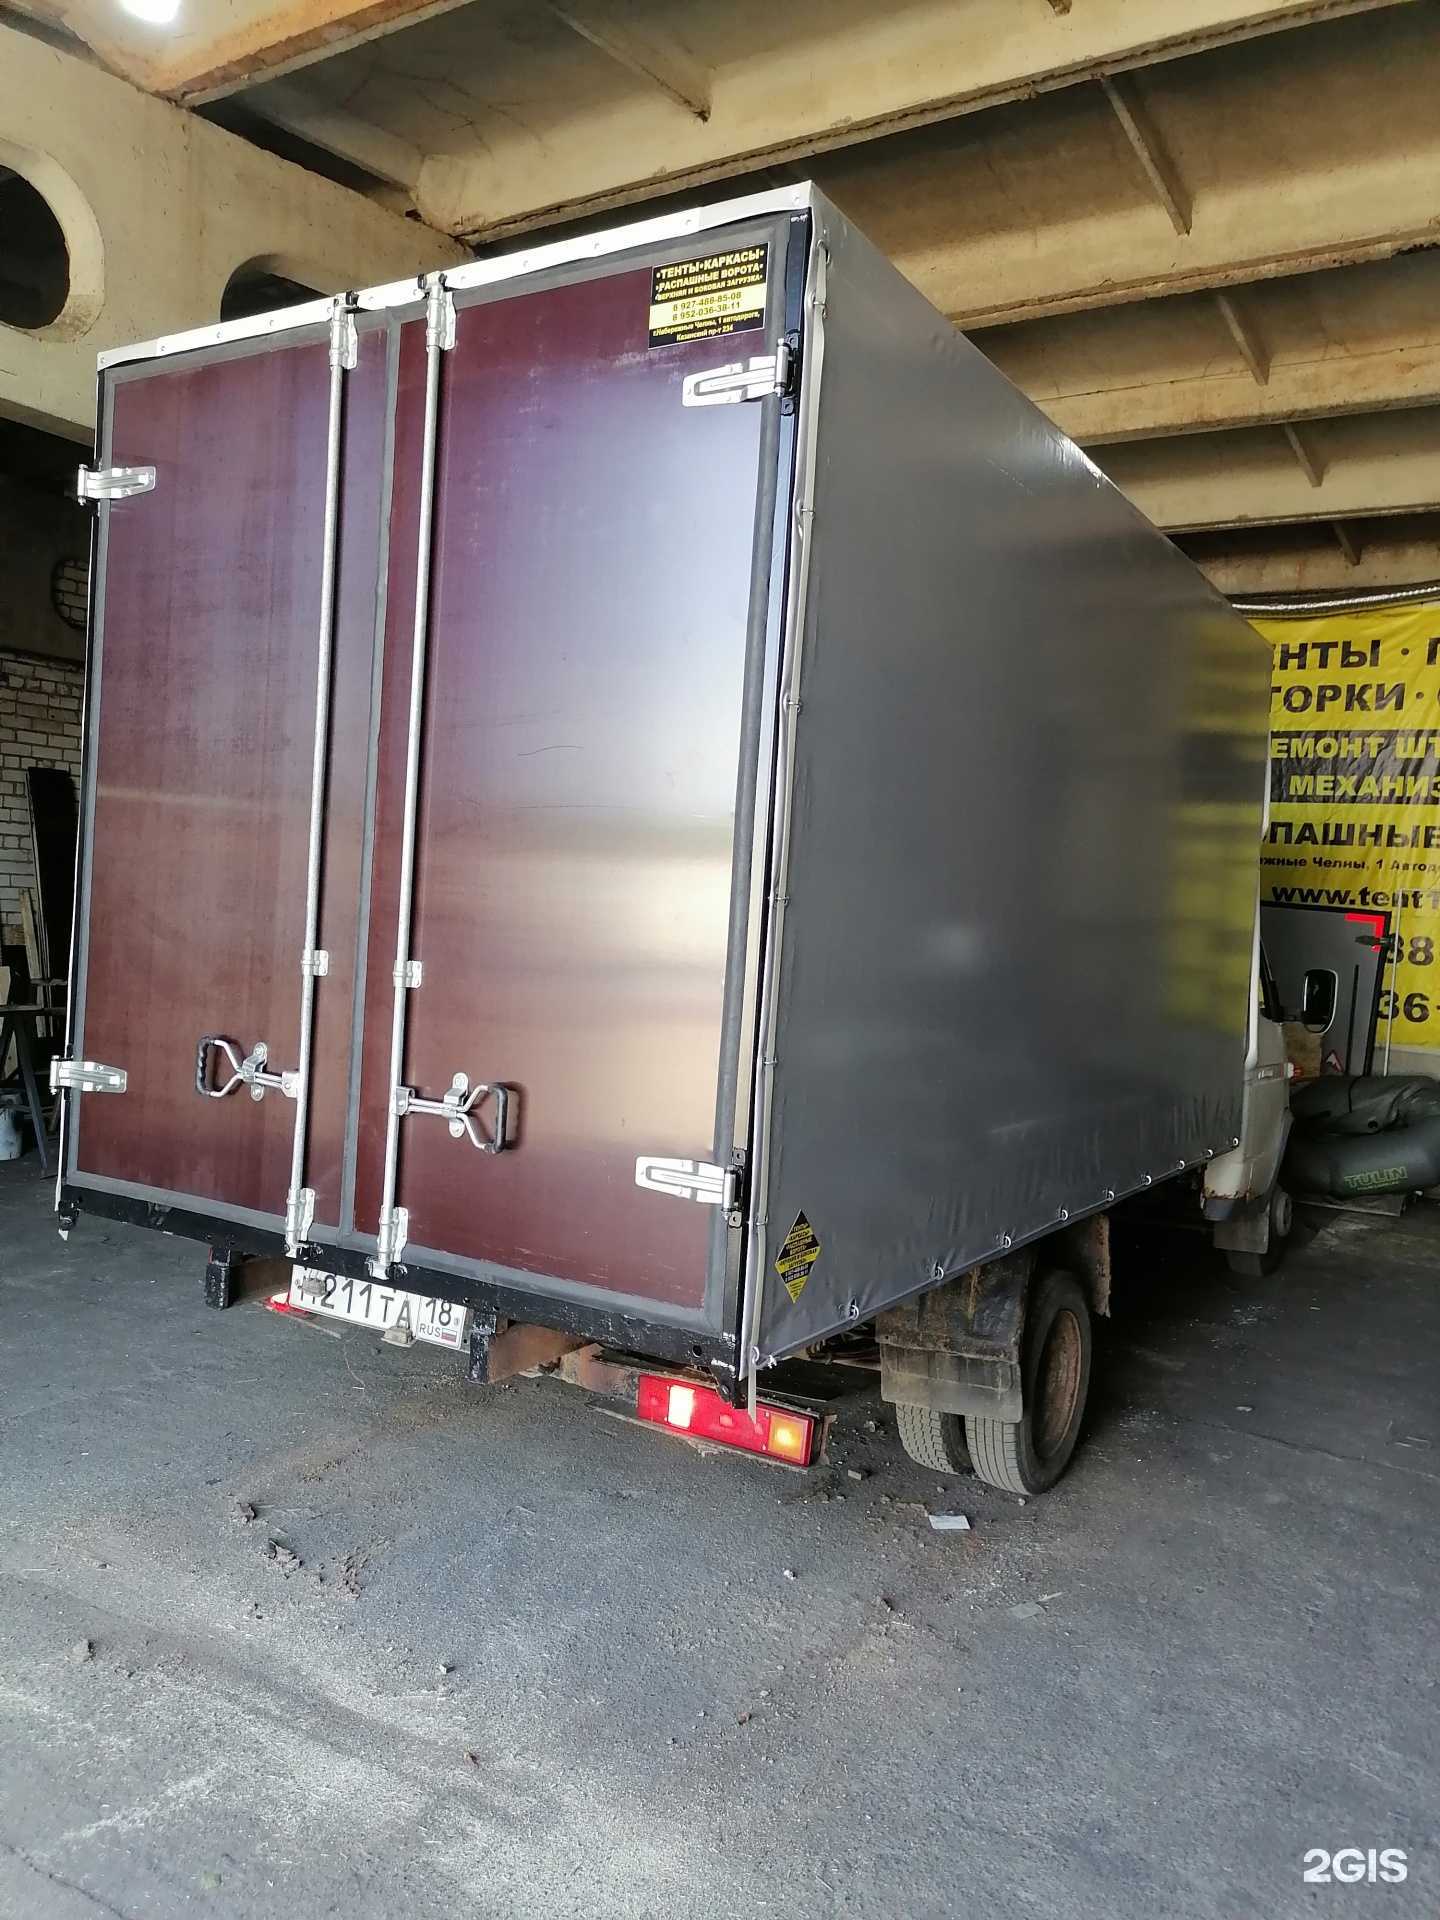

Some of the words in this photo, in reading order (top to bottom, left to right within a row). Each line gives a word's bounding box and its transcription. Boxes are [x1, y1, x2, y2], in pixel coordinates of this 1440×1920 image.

[1273, 639, 1381, 671] НТЫ
[1262, 821, 1440, 849] ПАШНЫЕ
[1376, 859, 1384, 870] 1
[425, 1298, 452, 1327] 18
[419, 1322, 441, 1338] RUS
